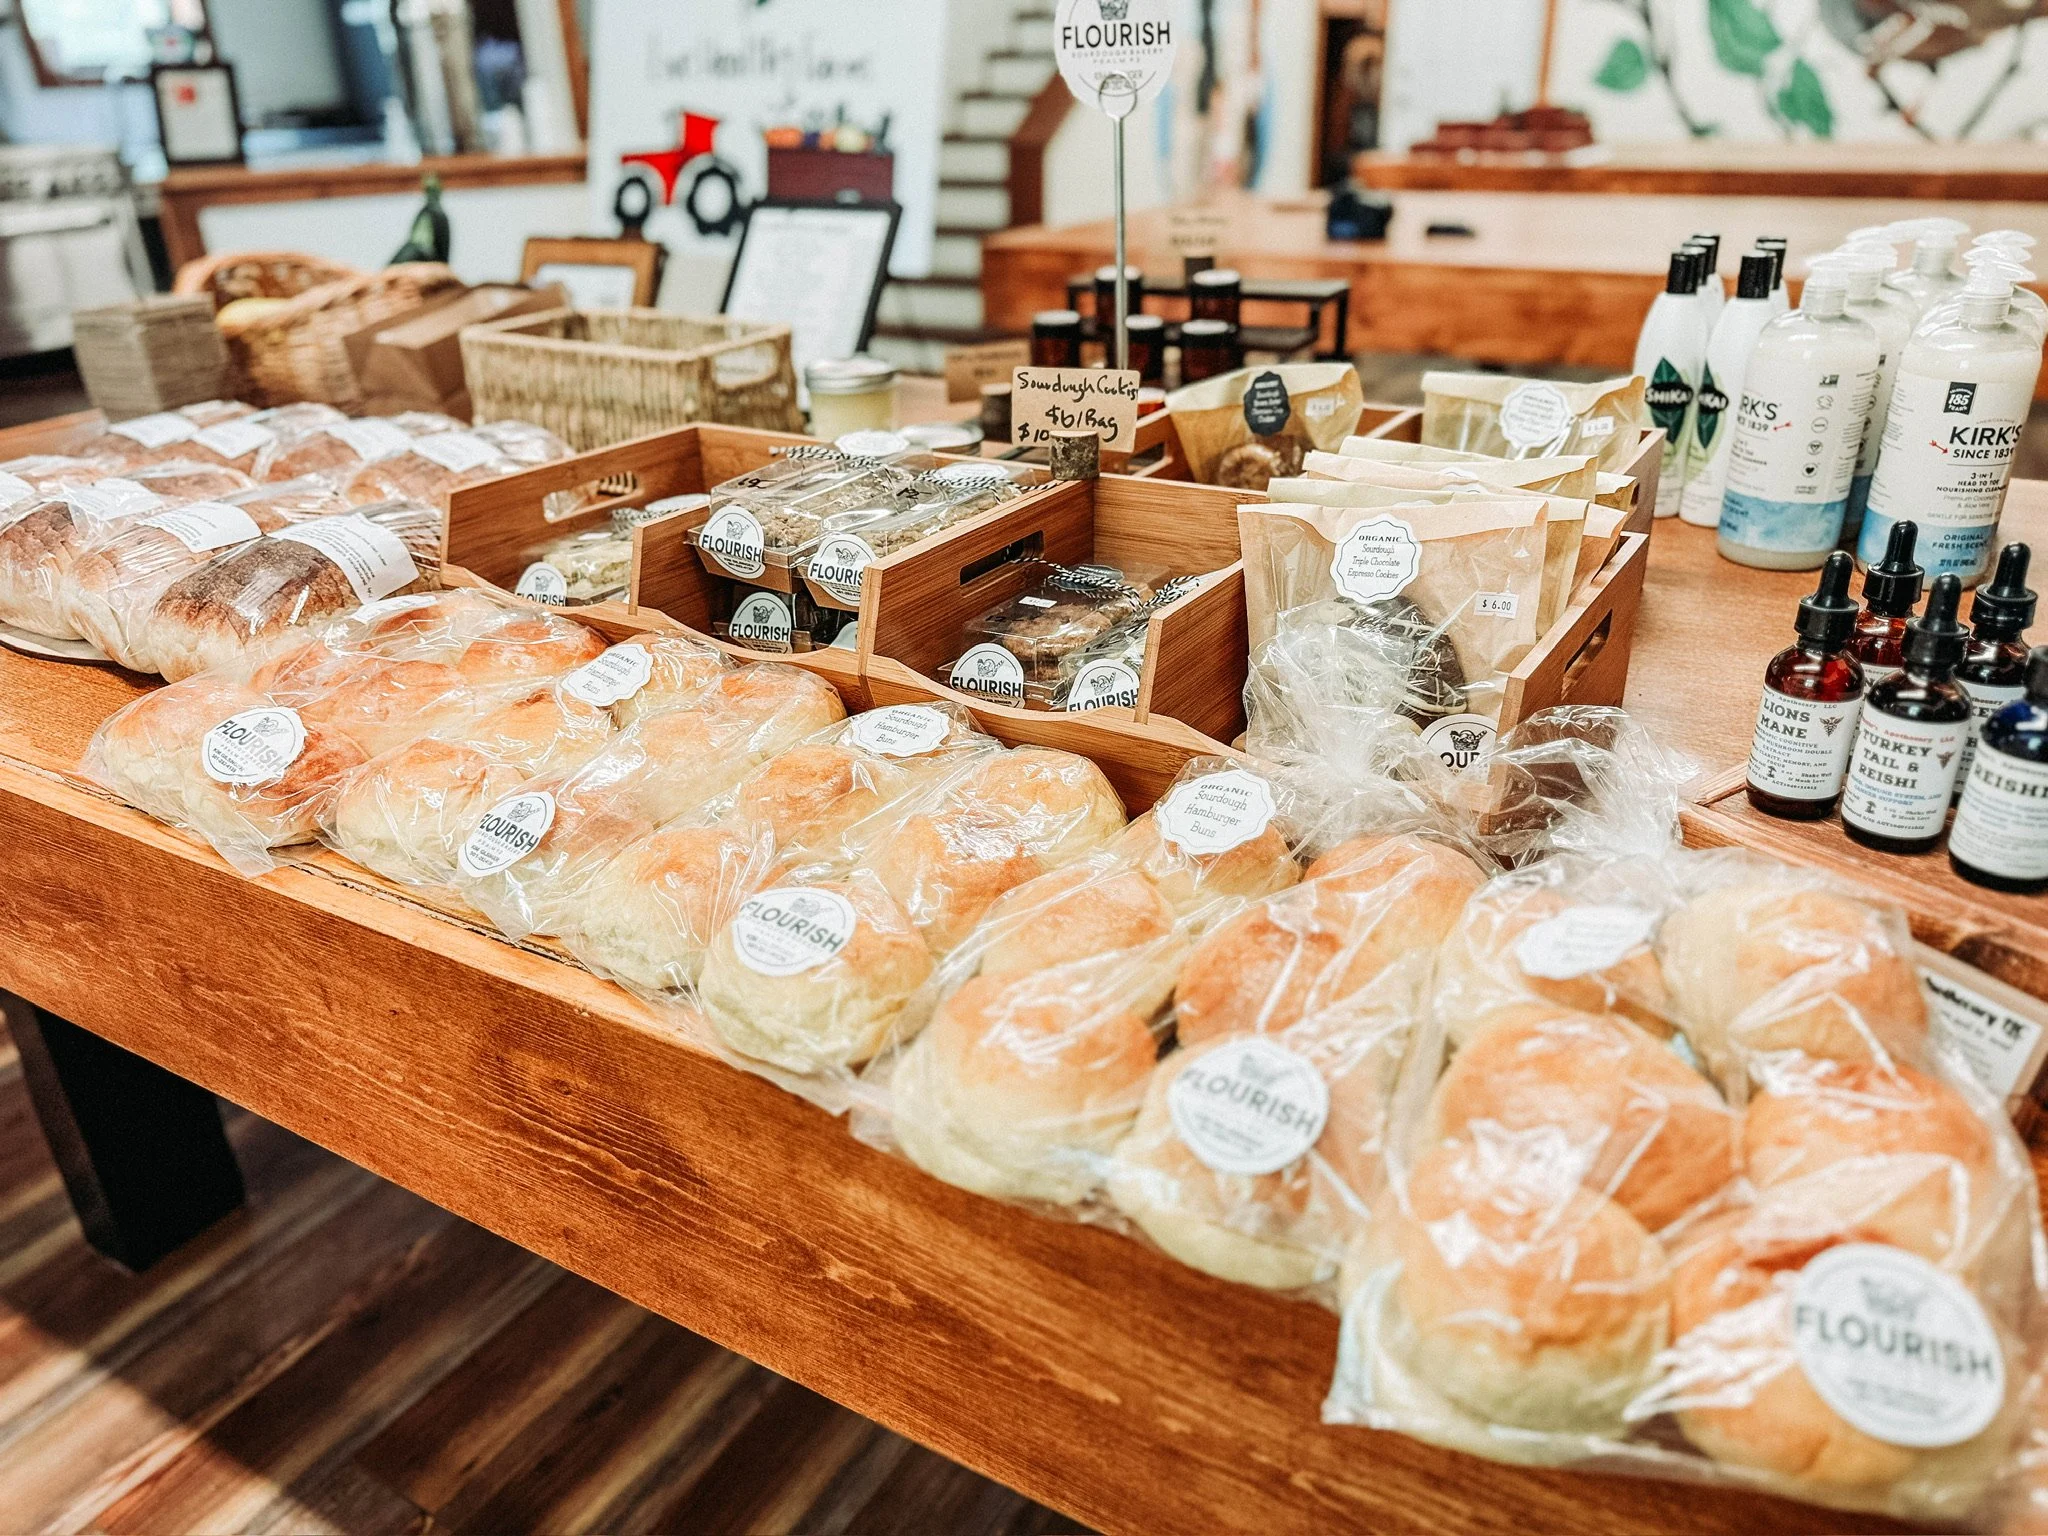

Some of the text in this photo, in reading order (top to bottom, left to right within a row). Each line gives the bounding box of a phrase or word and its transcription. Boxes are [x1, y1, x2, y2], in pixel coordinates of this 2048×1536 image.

[1062, 21, 1170, 49] FLOURISH
[1948, 393, 1971, 406] 185
[1950, 425, 2022, 446] KIRK'S
[1953, 449, 1990, 459] SINCE
[702, 534, 763, 563] FLOURISH
[1362, 544, 1395, 556] Sourdough
[1352, 556, 1400, 567] Triple Chocolate
[810, 563, 863, 586] FLOURIS
[1347, 567, 1399, 579] Espresso Cookies
[731, 623, 790, 641] FLOURISH
[951, 676, 1022, 698] FLOURISH
[1763, 698, 1811, 722] LIONS
[1779, 695, 1817, 709] Apothecary
[885, 714, 928, 730] Sourdough
[892, 709, 934, 722] ORGANIC
[874, 722, 920, 740] Hamburger
[1760, 714, 1808, 739] MANE
[216, 719, 288, 773] FLOURISH
[876, 733, 897, 745] Buns
[1766, 739, 1803, 754] MUSHROOM
[1779, 737, 1819, 749] COGNITIVE
[1863, 728, 1932, 757] TURKEY
[1763, 745, 1791, 758] EXTRACT
[1863, 747, 1919, 772] TAIL &
[1858, 762, 1918, 789] REISHI
[1200, 784, 1253, 796] ORGANIC
[1195, 790, 1247, 811] Sourdough
[1184, 803, 1241, 827] Hamburger
[1190, 821, 1217, 838] Buns
[740, 900, 845, 953] FLOURISH
[1181, 1067, 1320, 1136] FLOURISH
[1794, 1303, 1995, 1384] FLOURISH
